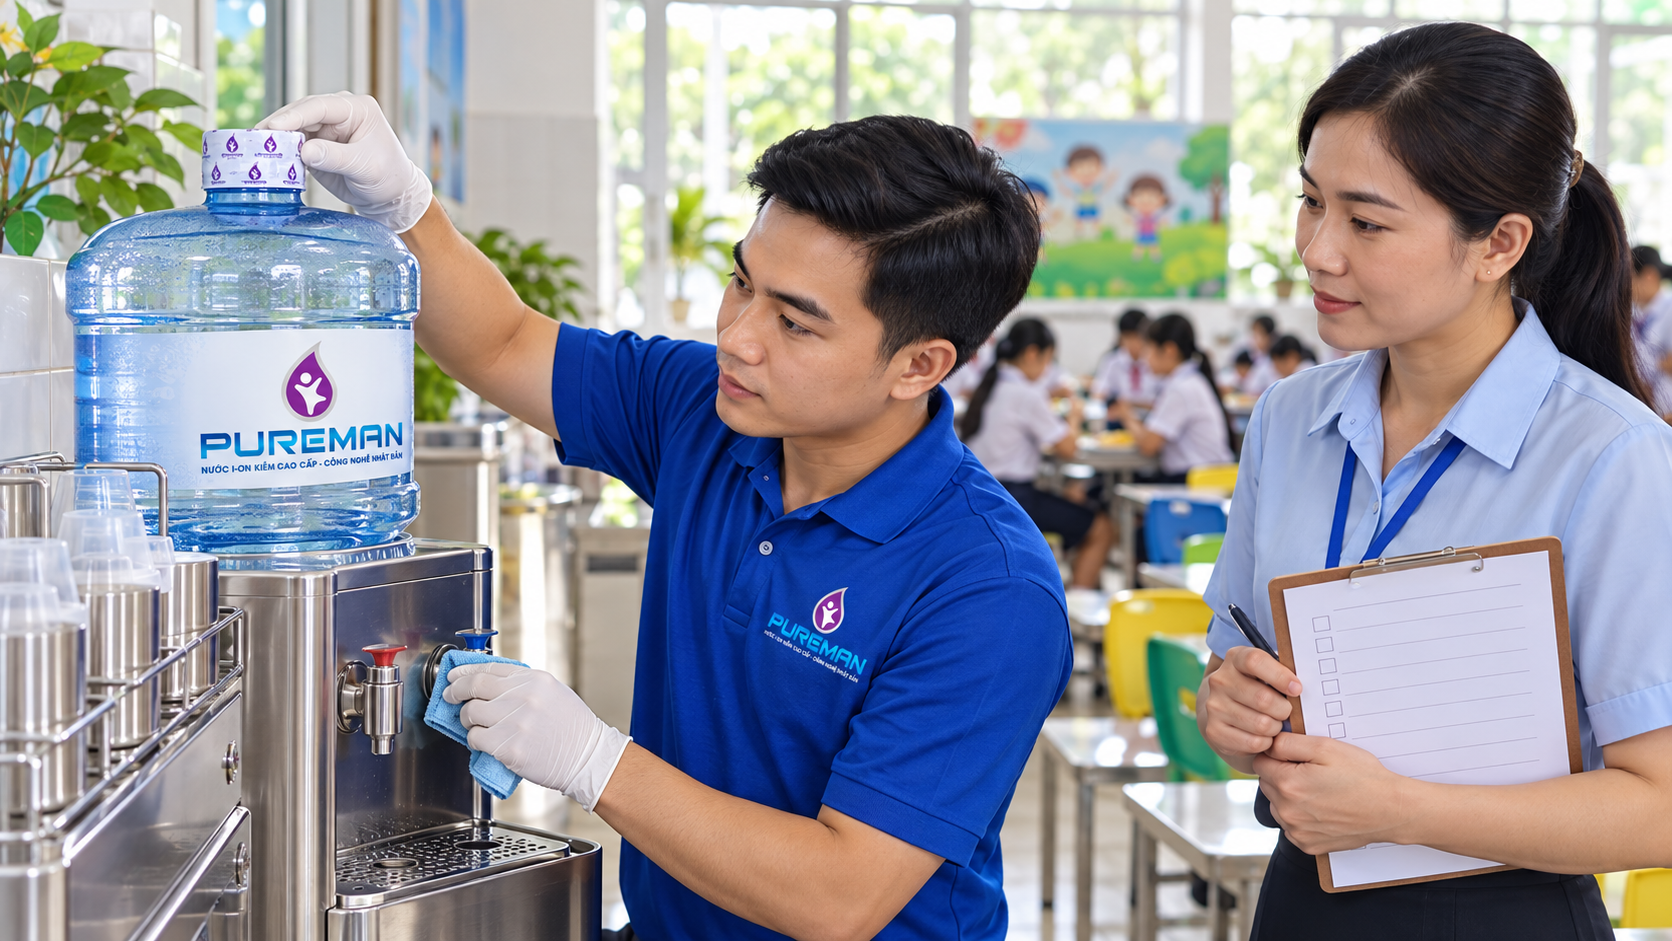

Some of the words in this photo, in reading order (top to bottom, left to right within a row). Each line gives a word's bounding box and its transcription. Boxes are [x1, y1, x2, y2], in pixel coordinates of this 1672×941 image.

[200, 422, 403, 459] PUREMAN
[201, 464, 229, 475] NƯỚC
[231, 464, 252, 473] I-ON
[277, 461, 297, 470] CAO
[767, 612, 867, 675] PUREMAN
